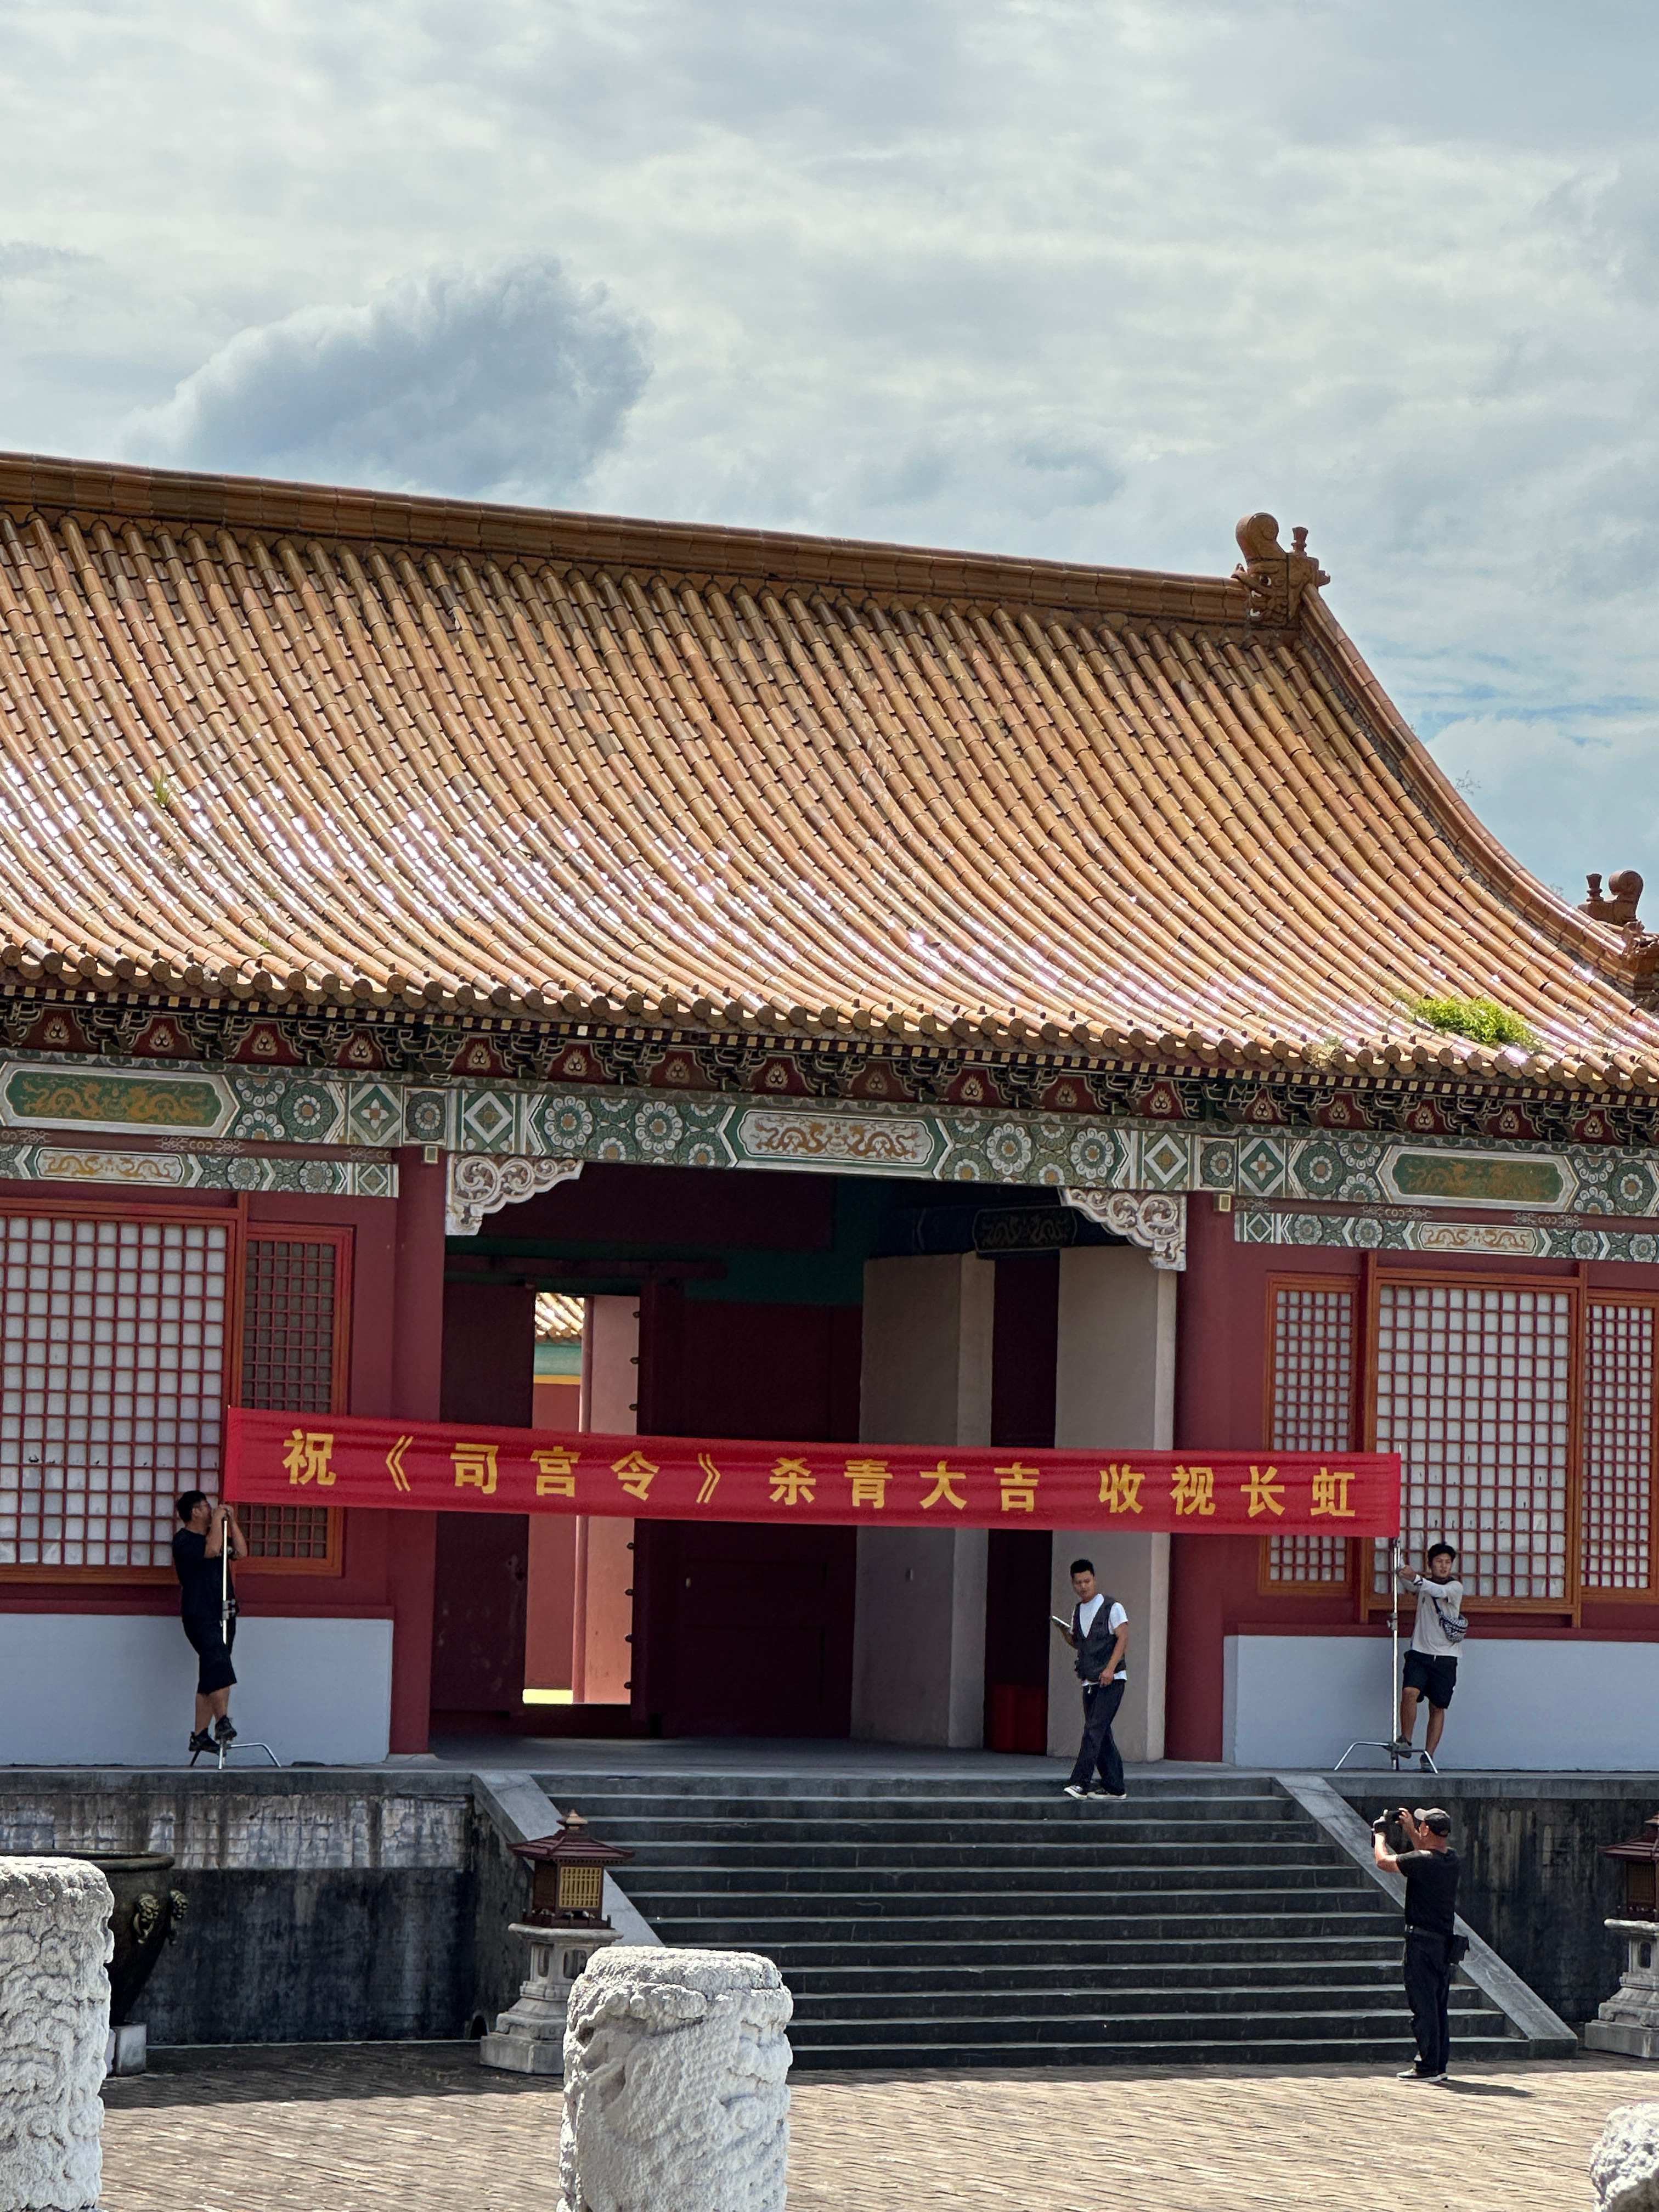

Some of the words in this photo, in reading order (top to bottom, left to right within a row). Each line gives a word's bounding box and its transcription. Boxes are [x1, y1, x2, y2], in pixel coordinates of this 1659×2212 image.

[282, 1429, 1040, 1512] 祝《司宫令》杀青大吉
[1098, 1464, 1355, 1517] 收视长虹
